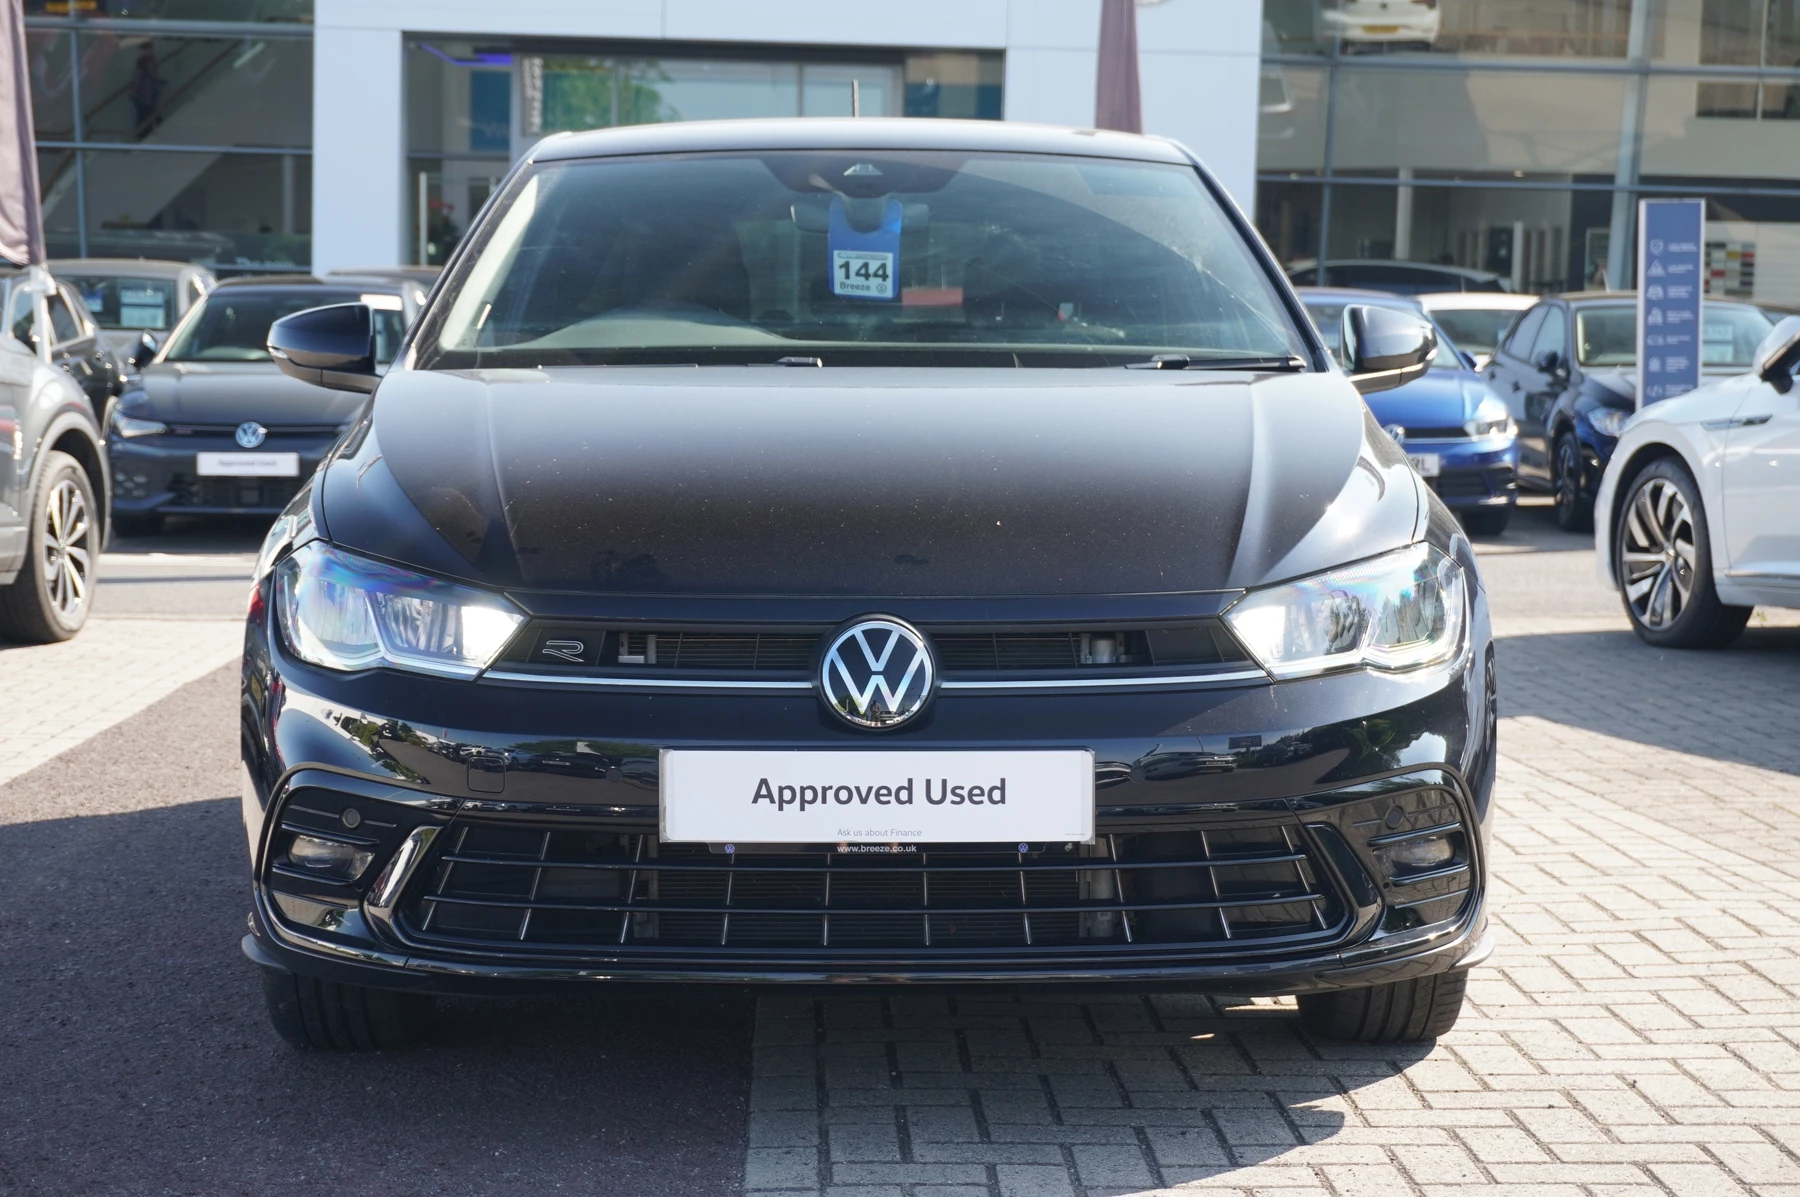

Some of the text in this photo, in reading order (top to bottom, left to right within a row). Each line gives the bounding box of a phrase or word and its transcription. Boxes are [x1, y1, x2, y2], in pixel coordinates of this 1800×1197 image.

[839, 260, 889, 282] 144
[840, 282, 871, 291] Breeze
[542, 640, 584, 662] R
[751, 777, 1007, 812] Approved Used
[837, 828, 852, 837] Ask
[864, 828, 889, 837] about
[890, 828, 922, 837] Finance
[837, 844, 917, 853] www.breeze.co.uk
